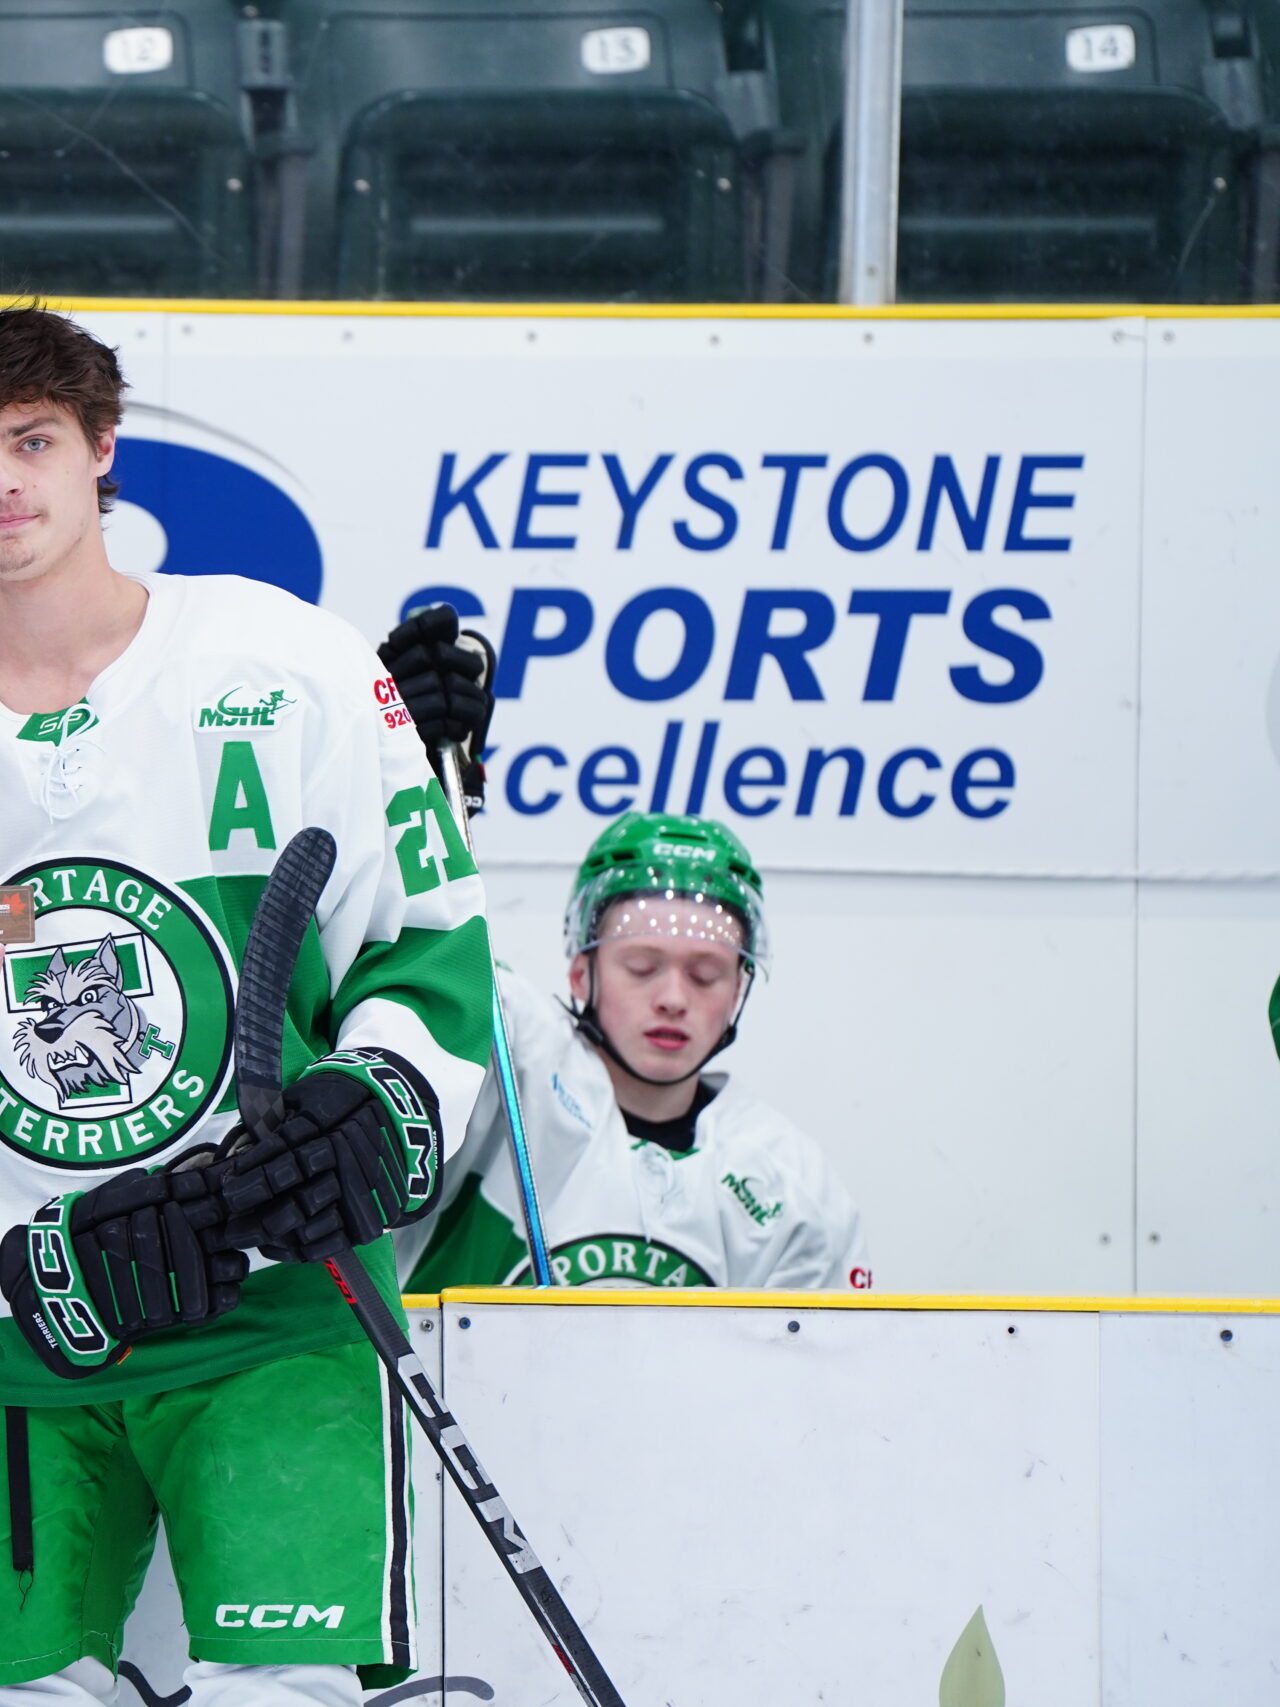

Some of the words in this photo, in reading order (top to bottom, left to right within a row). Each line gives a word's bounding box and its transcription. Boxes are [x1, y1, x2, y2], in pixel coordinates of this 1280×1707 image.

[1083, 35, 1120, 63] 14
[423, 452, 1086, 553] KEYSTONE
[199, 706, 276, 728] MJHL
[208, 741, 278, 851] A
[385, 776, 480, 897] 21
[652, 842, 717, 862] CCM
[21, 867, 172, 931] RTAGE
[551, 1241, 700, 1288] PORTA
[32, 1311, 60, 1349] TERRIERS
[396, 1352, 543, 1575] CCM
[215, 1604, 345, 1629] CCM
